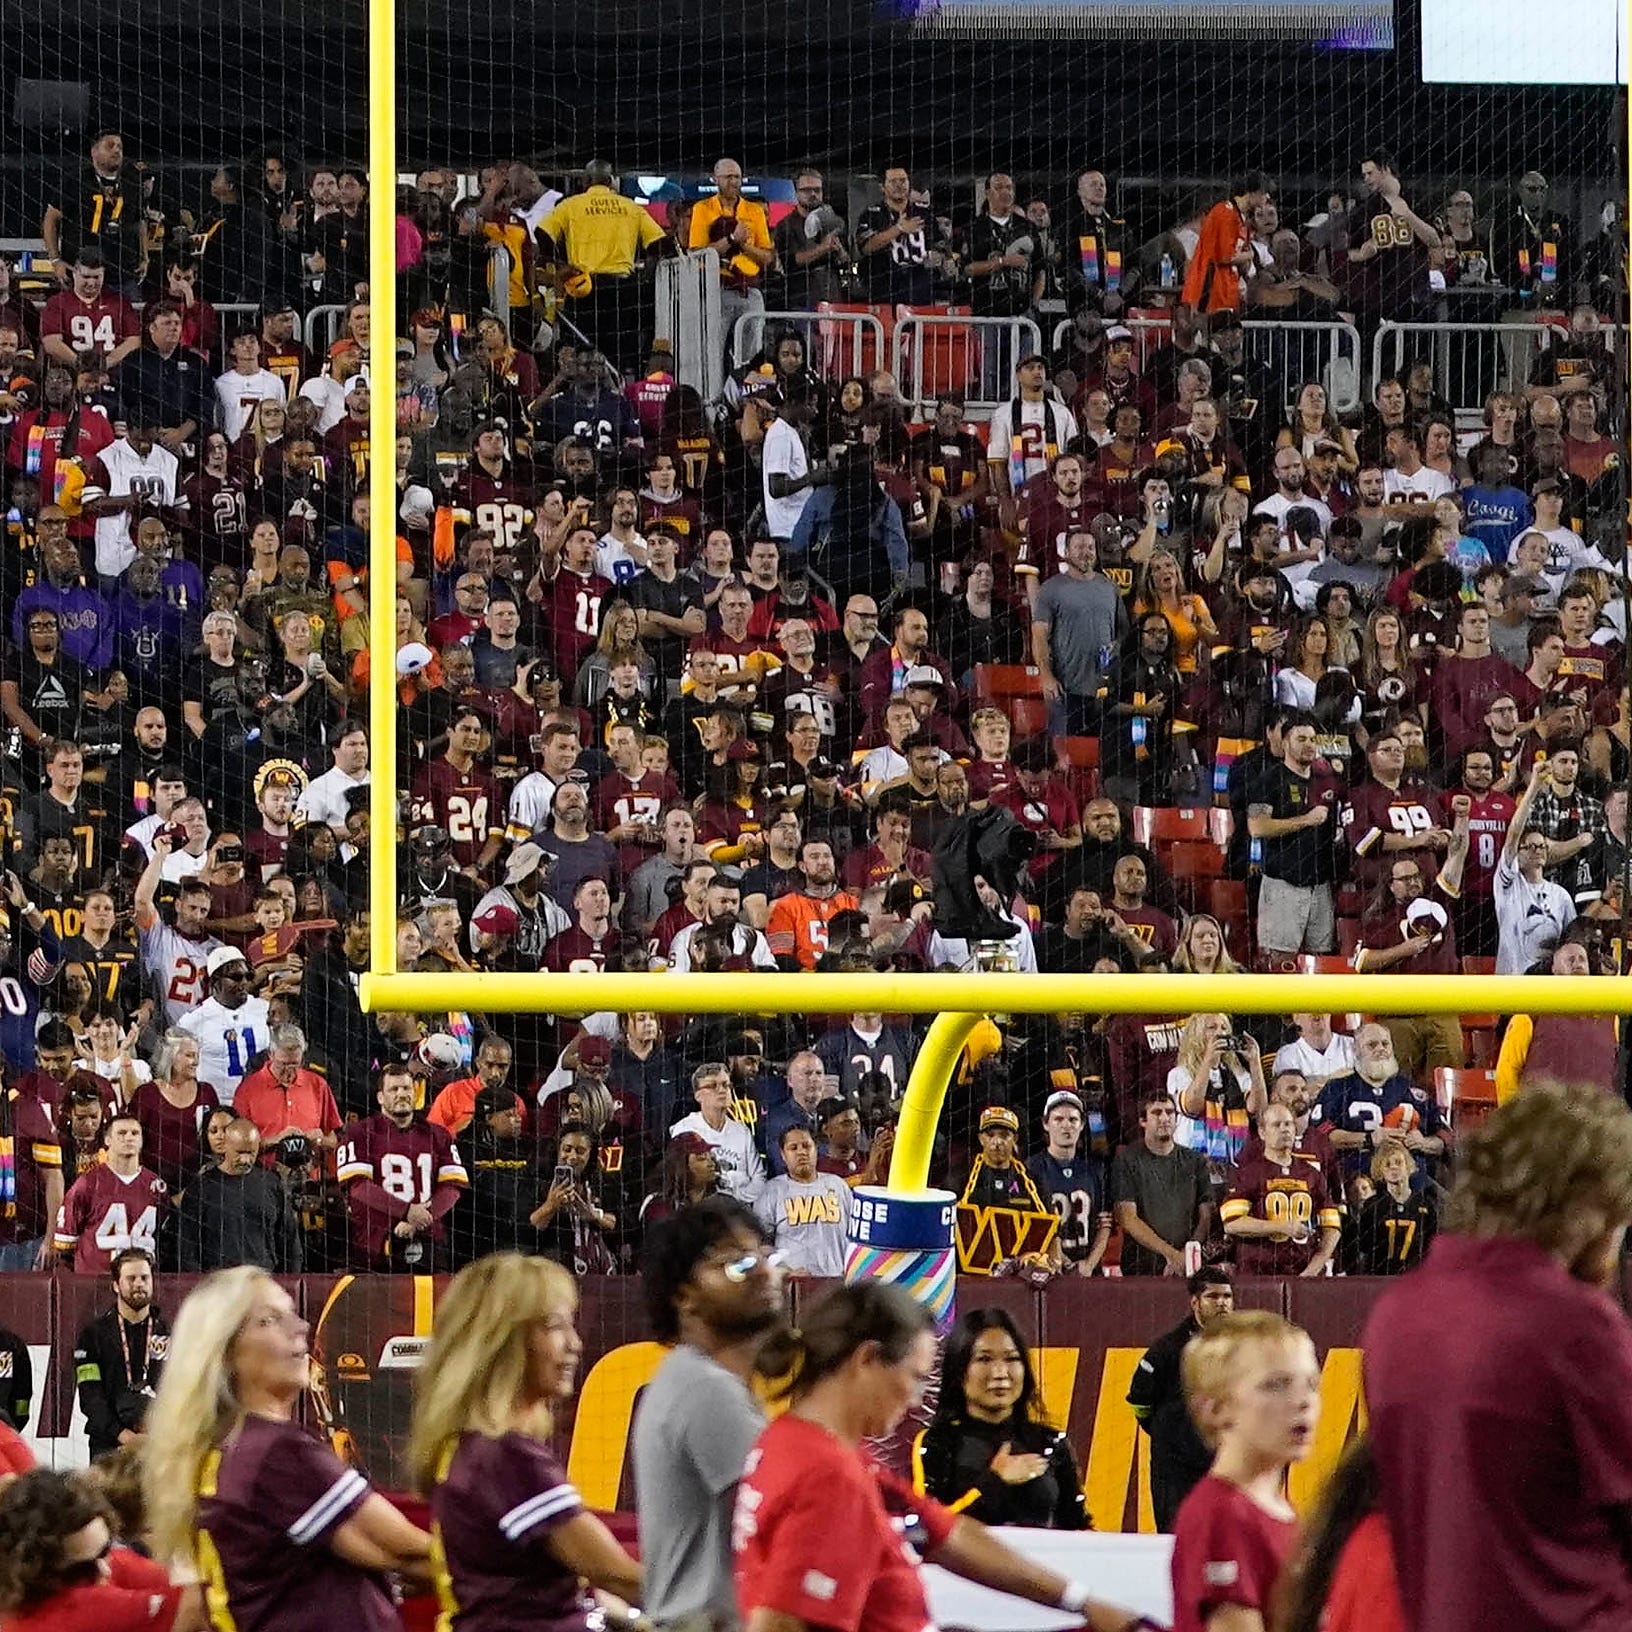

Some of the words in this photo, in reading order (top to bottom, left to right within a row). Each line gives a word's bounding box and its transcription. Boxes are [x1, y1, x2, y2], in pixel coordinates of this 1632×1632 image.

[1370, 214, 1413, 248] 88
[72, 315, 115, 351] 94
[213, 492, 248, 532] 21
[575, 591, 602, 634] 11
[448, 796, 486, 841] 24
[1388, 807, 1431, 838] 99
[1479, 834, 1494, 867] 8
[222, 1029, 257, 1076] 11
[338, 1141, 356, 1163] 81
[381, 1152, 432, 1203] 81
[786, 1197, 840, 1225] WAS
[96, 1203, 155, 1259] 44
[1385, 1219, 1415, 1258] 17
